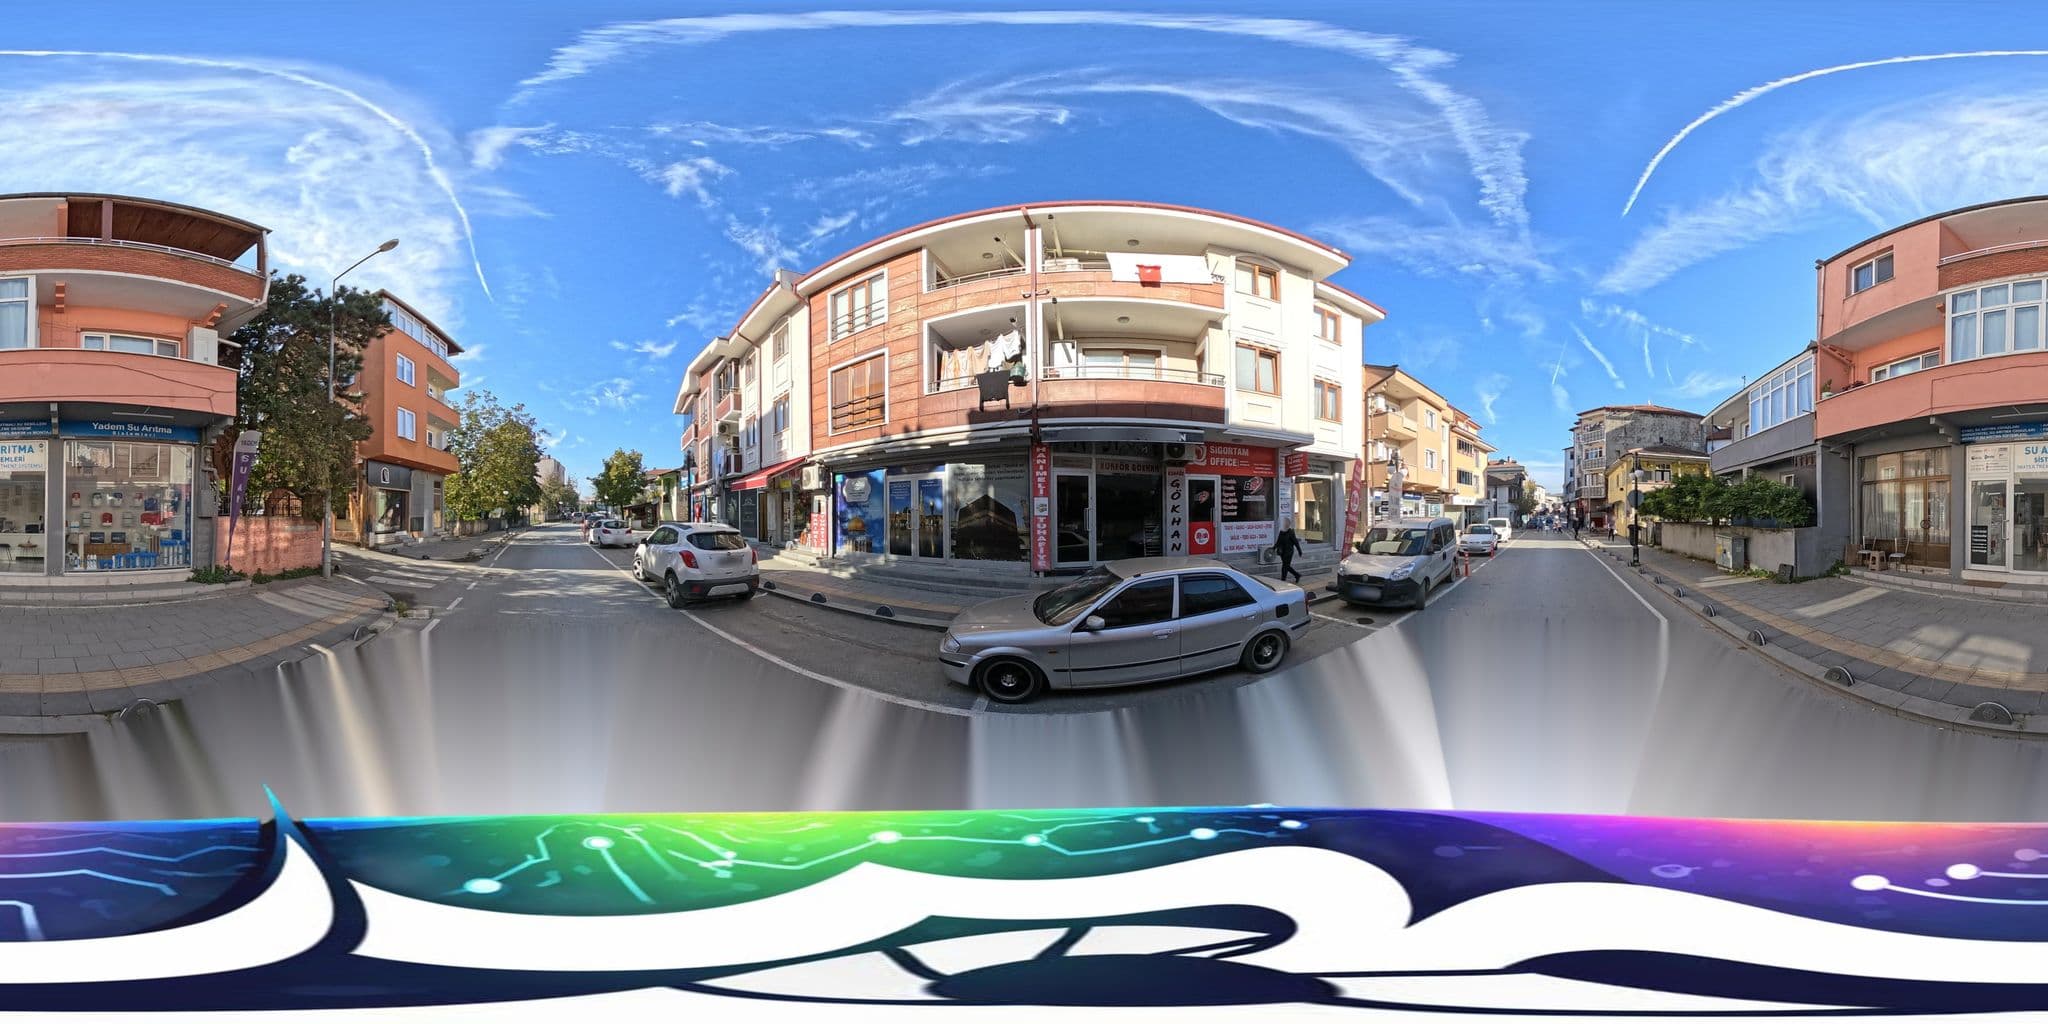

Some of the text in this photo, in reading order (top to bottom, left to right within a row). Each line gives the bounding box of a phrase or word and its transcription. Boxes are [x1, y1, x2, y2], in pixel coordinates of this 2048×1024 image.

[92, 422, 125, 431] Yadem
[127, 423, 140, 432] Su
[2024, 446, 2038, 455] SU
[1210, 457, 1238, 467] OFFICE
[1170, 478, 1182, 552] GÖKHAN
